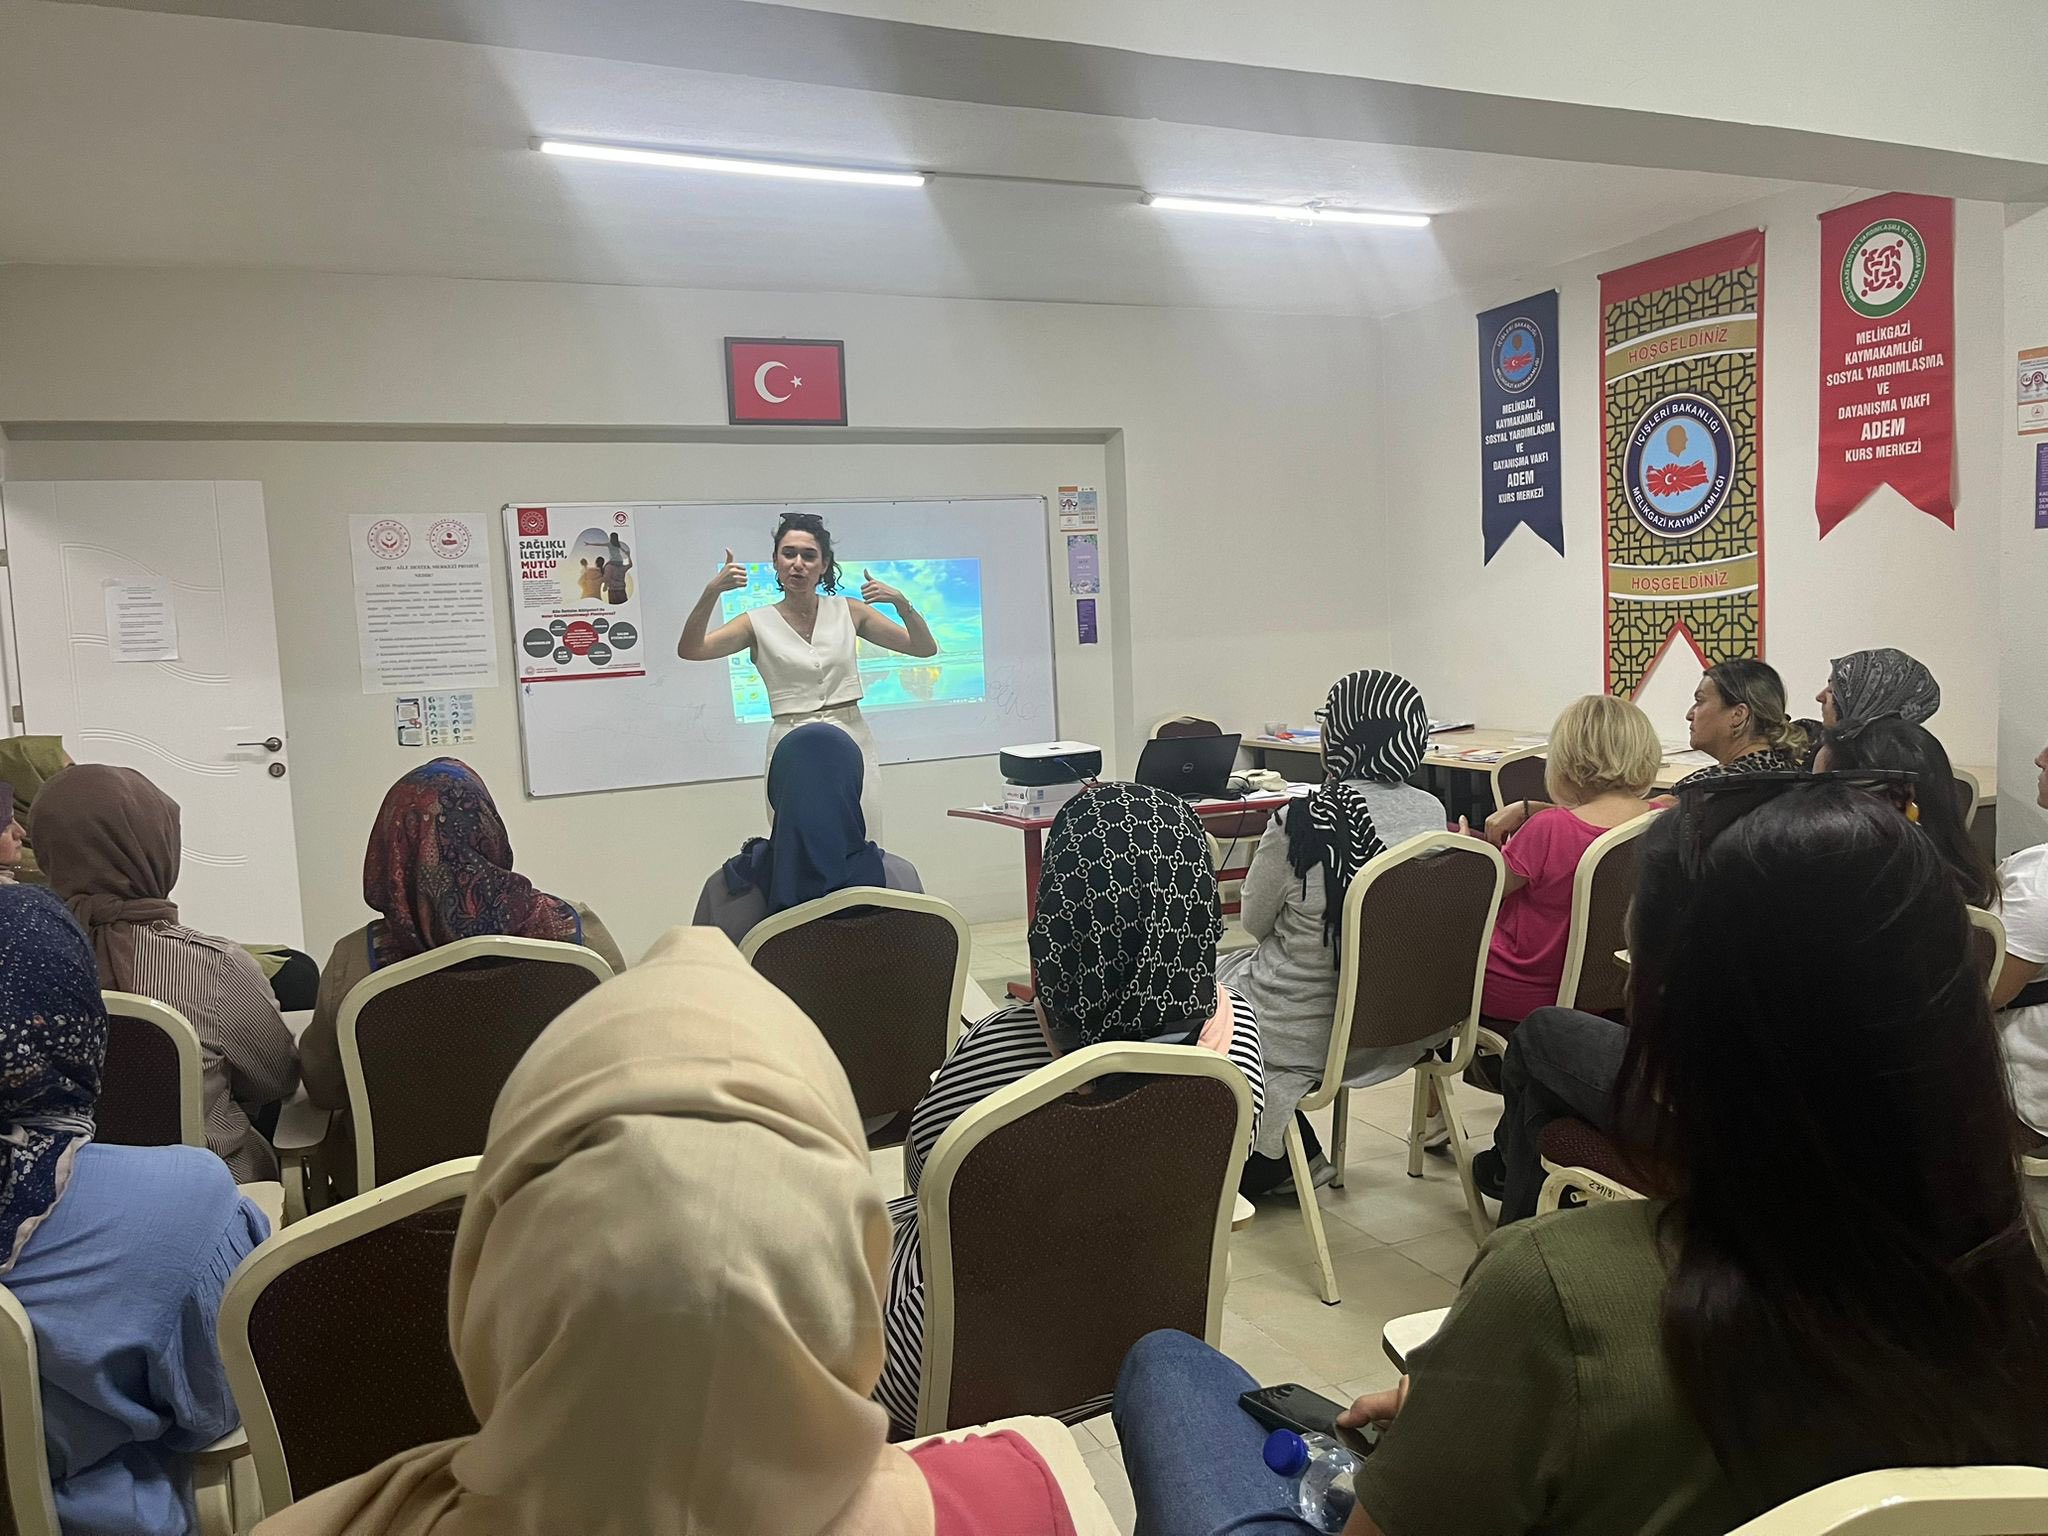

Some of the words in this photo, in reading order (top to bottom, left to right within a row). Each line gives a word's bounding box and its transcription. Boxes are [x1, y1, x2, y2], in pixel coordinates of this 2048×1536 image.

[1856, 319, 1911, 346] MELİKGAZİ
[1628, 326, 1728, 363] HOŞGELDİNİZ
[1845, 337, 1923, 366] KAYMAKAMLIĞI
[1826, 368, 1864, 387] SOSYAL
[1866, 353, 1944, 379] YARDIMLAŞMA
[1877, 382, 1890, 396] VE
[1502, 396, 1536, 415] MELİKGAZİ
[1838, 399, 1898, 420] DAYANIŞMA
[1900, 393, 1930, 411] VAKFI
[1495, 409, 1543, 430] KAYMAKAMLIĞI
[1634, 404, 1671, 447] İÇİŞLERİ
[1672, 403, 1721, 434] BAKANLIĞI
[1861, 417, 1905, 441] ADEM
[1485, 432, 1508, 445] SOSYAL
[1509, 422, 1555, 441] YARDIMLAŞMA
[1515, 442, 1524, 453] VE
[1845, 447, 1873, 463] KURS
[1876, 437, 1921, 459] MERKEZİ
[1493, 455, 1529, 471] DAYANIŞMA
[1530, 451, 1549, 464] VAKFI
[1507, 470, 1534, 488] ADEM
[1498, 492, 1515, 504] KURS
[1516, 485, 1544, 501] MERKEZİ
[1632, 486, 1668, 528] MELİKGAZİ
[1668, 475, 1726, 529] KAYMAKAMLIĞI
[519, 538, 566, 550] SAĞLIKLI
[520, 549, 568, 560] İLETİŞİM,
[521, 560, 556, 569] MUTLU
[522, 569, 548, 579] AİLE!
[1631, 569, 1728, 593] HOŞGELDİNİZ
